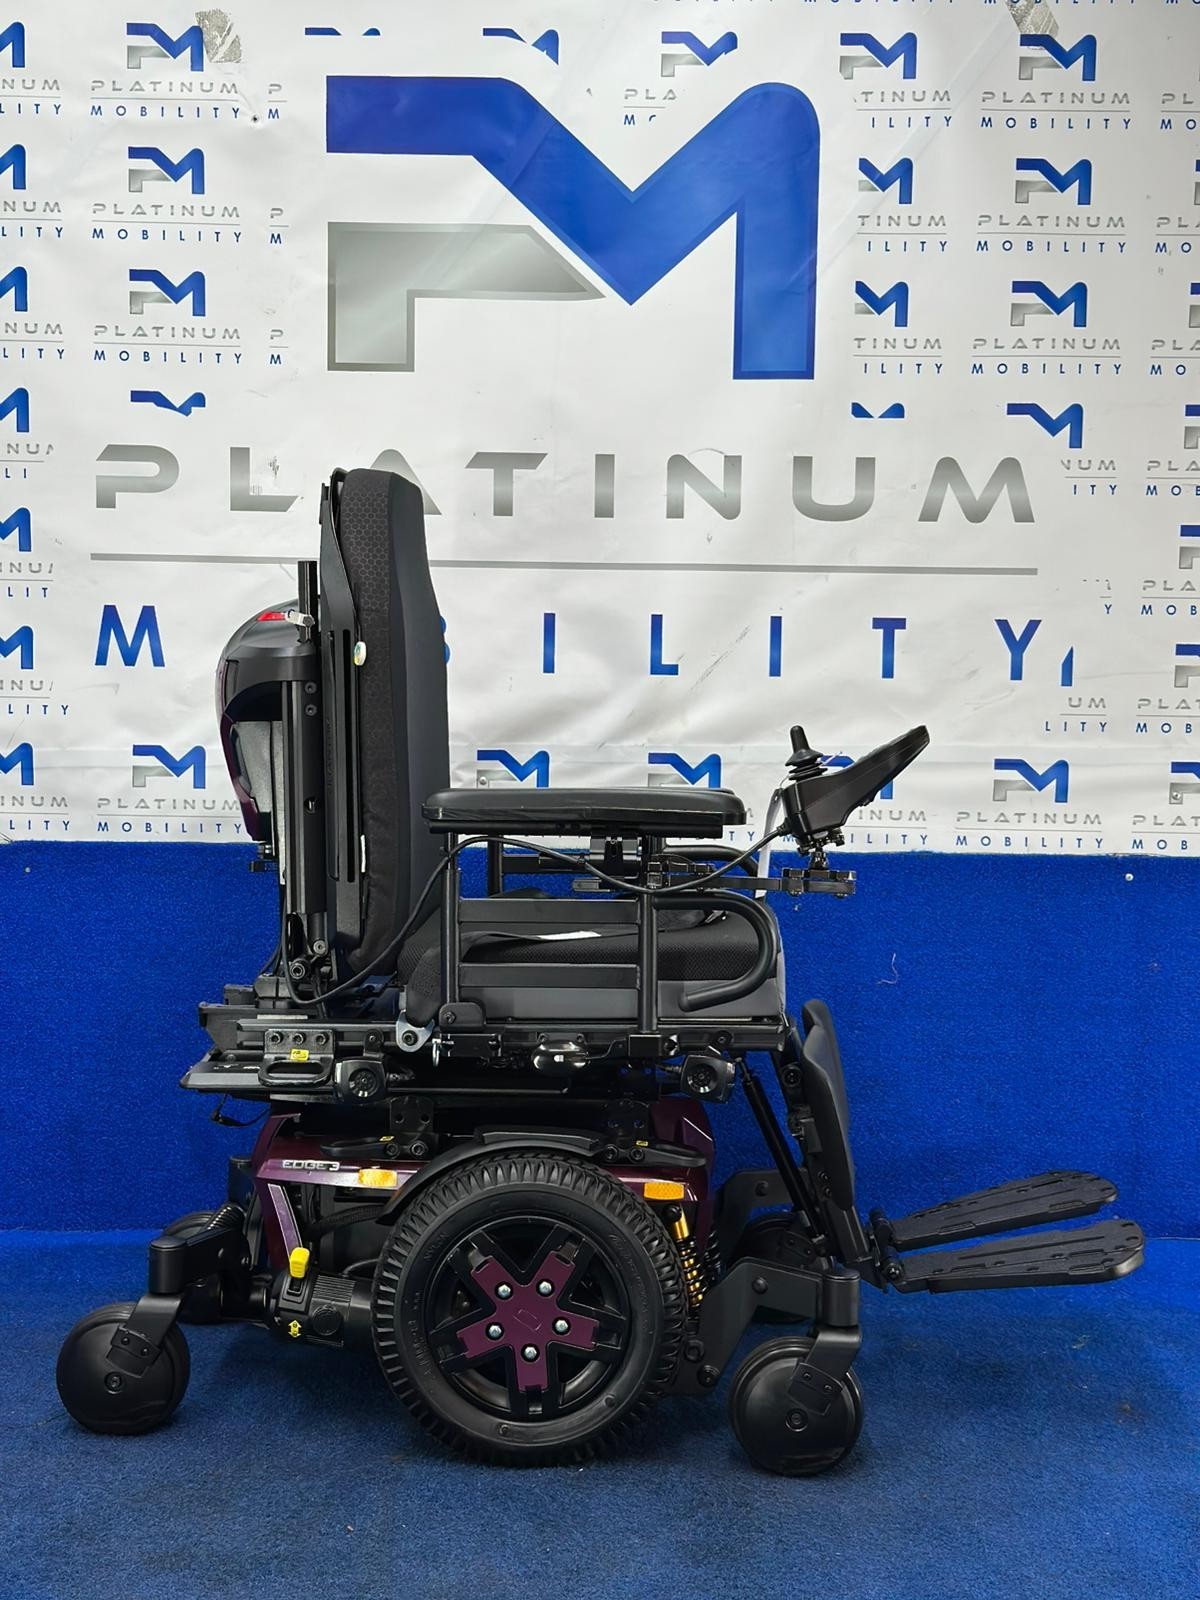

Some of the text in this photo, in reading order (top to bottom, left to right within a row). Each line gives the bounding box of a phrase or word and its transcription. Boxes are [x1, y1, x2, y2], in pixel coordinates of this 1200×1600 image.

[91, 80, 238, 94] PLATINUM
[982, 92, 1130, 104] PLATINUM
[91, 105, 239, 118] MOBILITY
[981, 117, 1131, 130] MOBILITY
[92, 203, 240, 218] PLATINUM
[326, 75, 820, 380] PM
[978, 215, 1125, 228] PLATINUM
[92, 228, 241, 243] MOBILITY
[977, 240, 1126, 253] MOBILITY
[94, 325, 241, 340] PLATINUM
[973, 338, 1120, 350] PLATINUM
[94, 350, 241, 364] MOBILITY
[971, 363, 1121, 375] MOBILITY
[95, 604, 1041, 684] MILITY
[97, 799, 240, 811] PLATINUM
[957, 812, 1101, 824] PLATINUM
[97, 822, 241, 834] MOBILITY
[956, 835, 1103, 848] MOBILITY
[282, 1160, 340, 1171] EDGE 3
